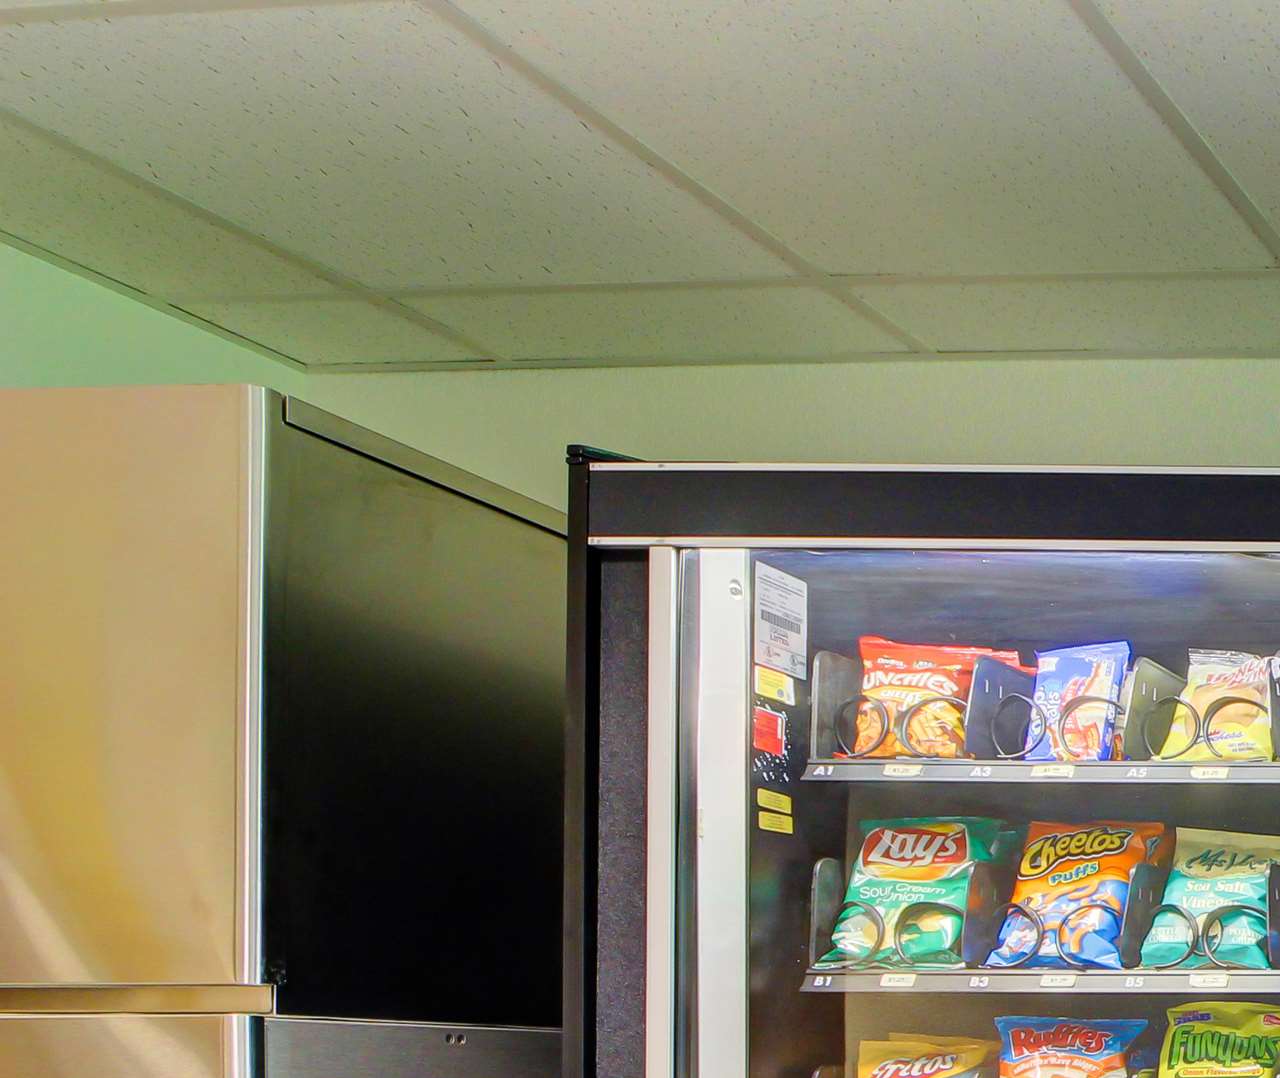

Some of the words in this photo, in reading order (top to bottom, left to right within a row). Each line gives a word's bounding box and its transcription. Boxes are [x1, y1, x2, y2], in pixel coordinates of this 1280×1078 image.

[862, 671, 959, 695] UNCHIES
[813, 766, 834, 776] A1
[970, 767, 992, 776] A3
[1127, 768, 1148, 777] A5
[868, 830, 958, 868] Lay's
[1020, 827, 1128, 876] Cheetos
[1050, 861, 1099, 885] Puffs
[814, 976, 832, 986] B1
[969, 977, 989, 987] B3
[1125, 978, 1144, 987] B5
[1009, 1023, 1114, 1059] Ruffles
